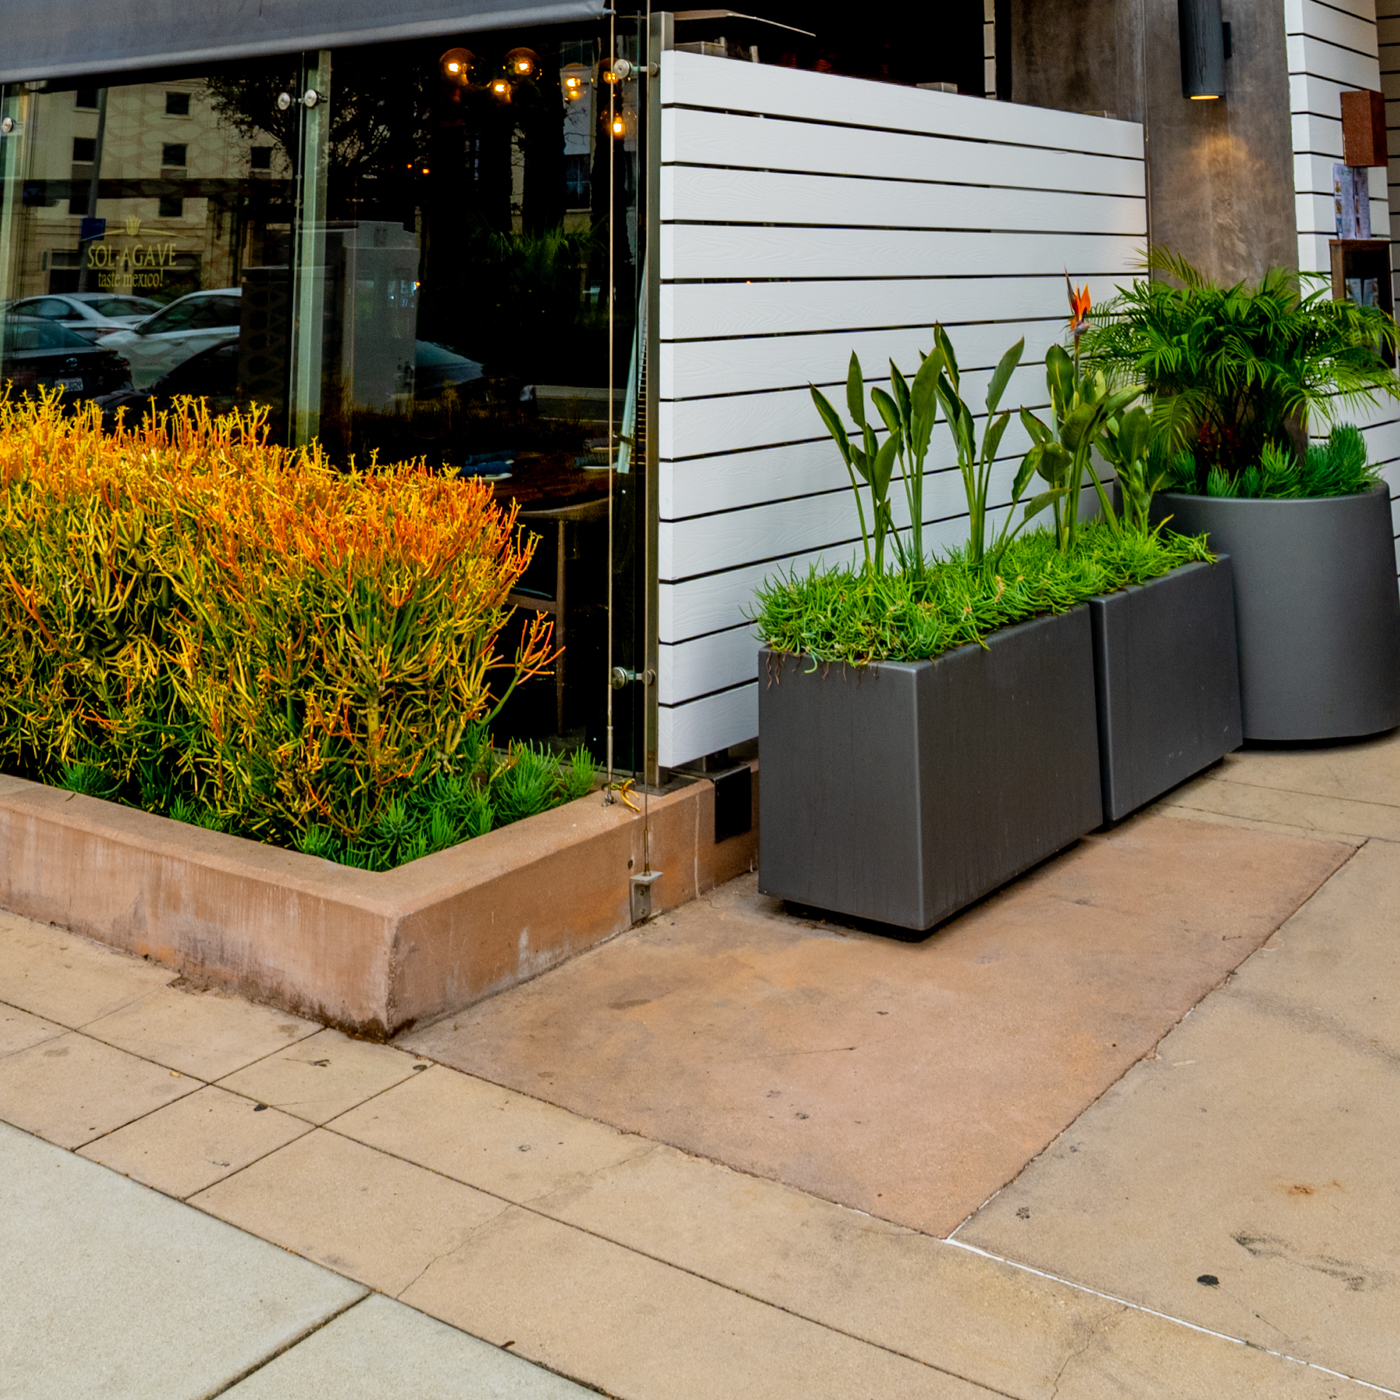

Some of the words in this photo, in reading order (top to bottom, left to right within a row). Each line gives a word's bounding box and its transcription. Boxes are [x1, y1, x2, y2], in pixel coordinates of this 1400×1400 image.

[87, 243, 177, 268] SOL-AGAVE
[98, 271, 120, 288] taste
[123, 267, 163, 288] mexico!
